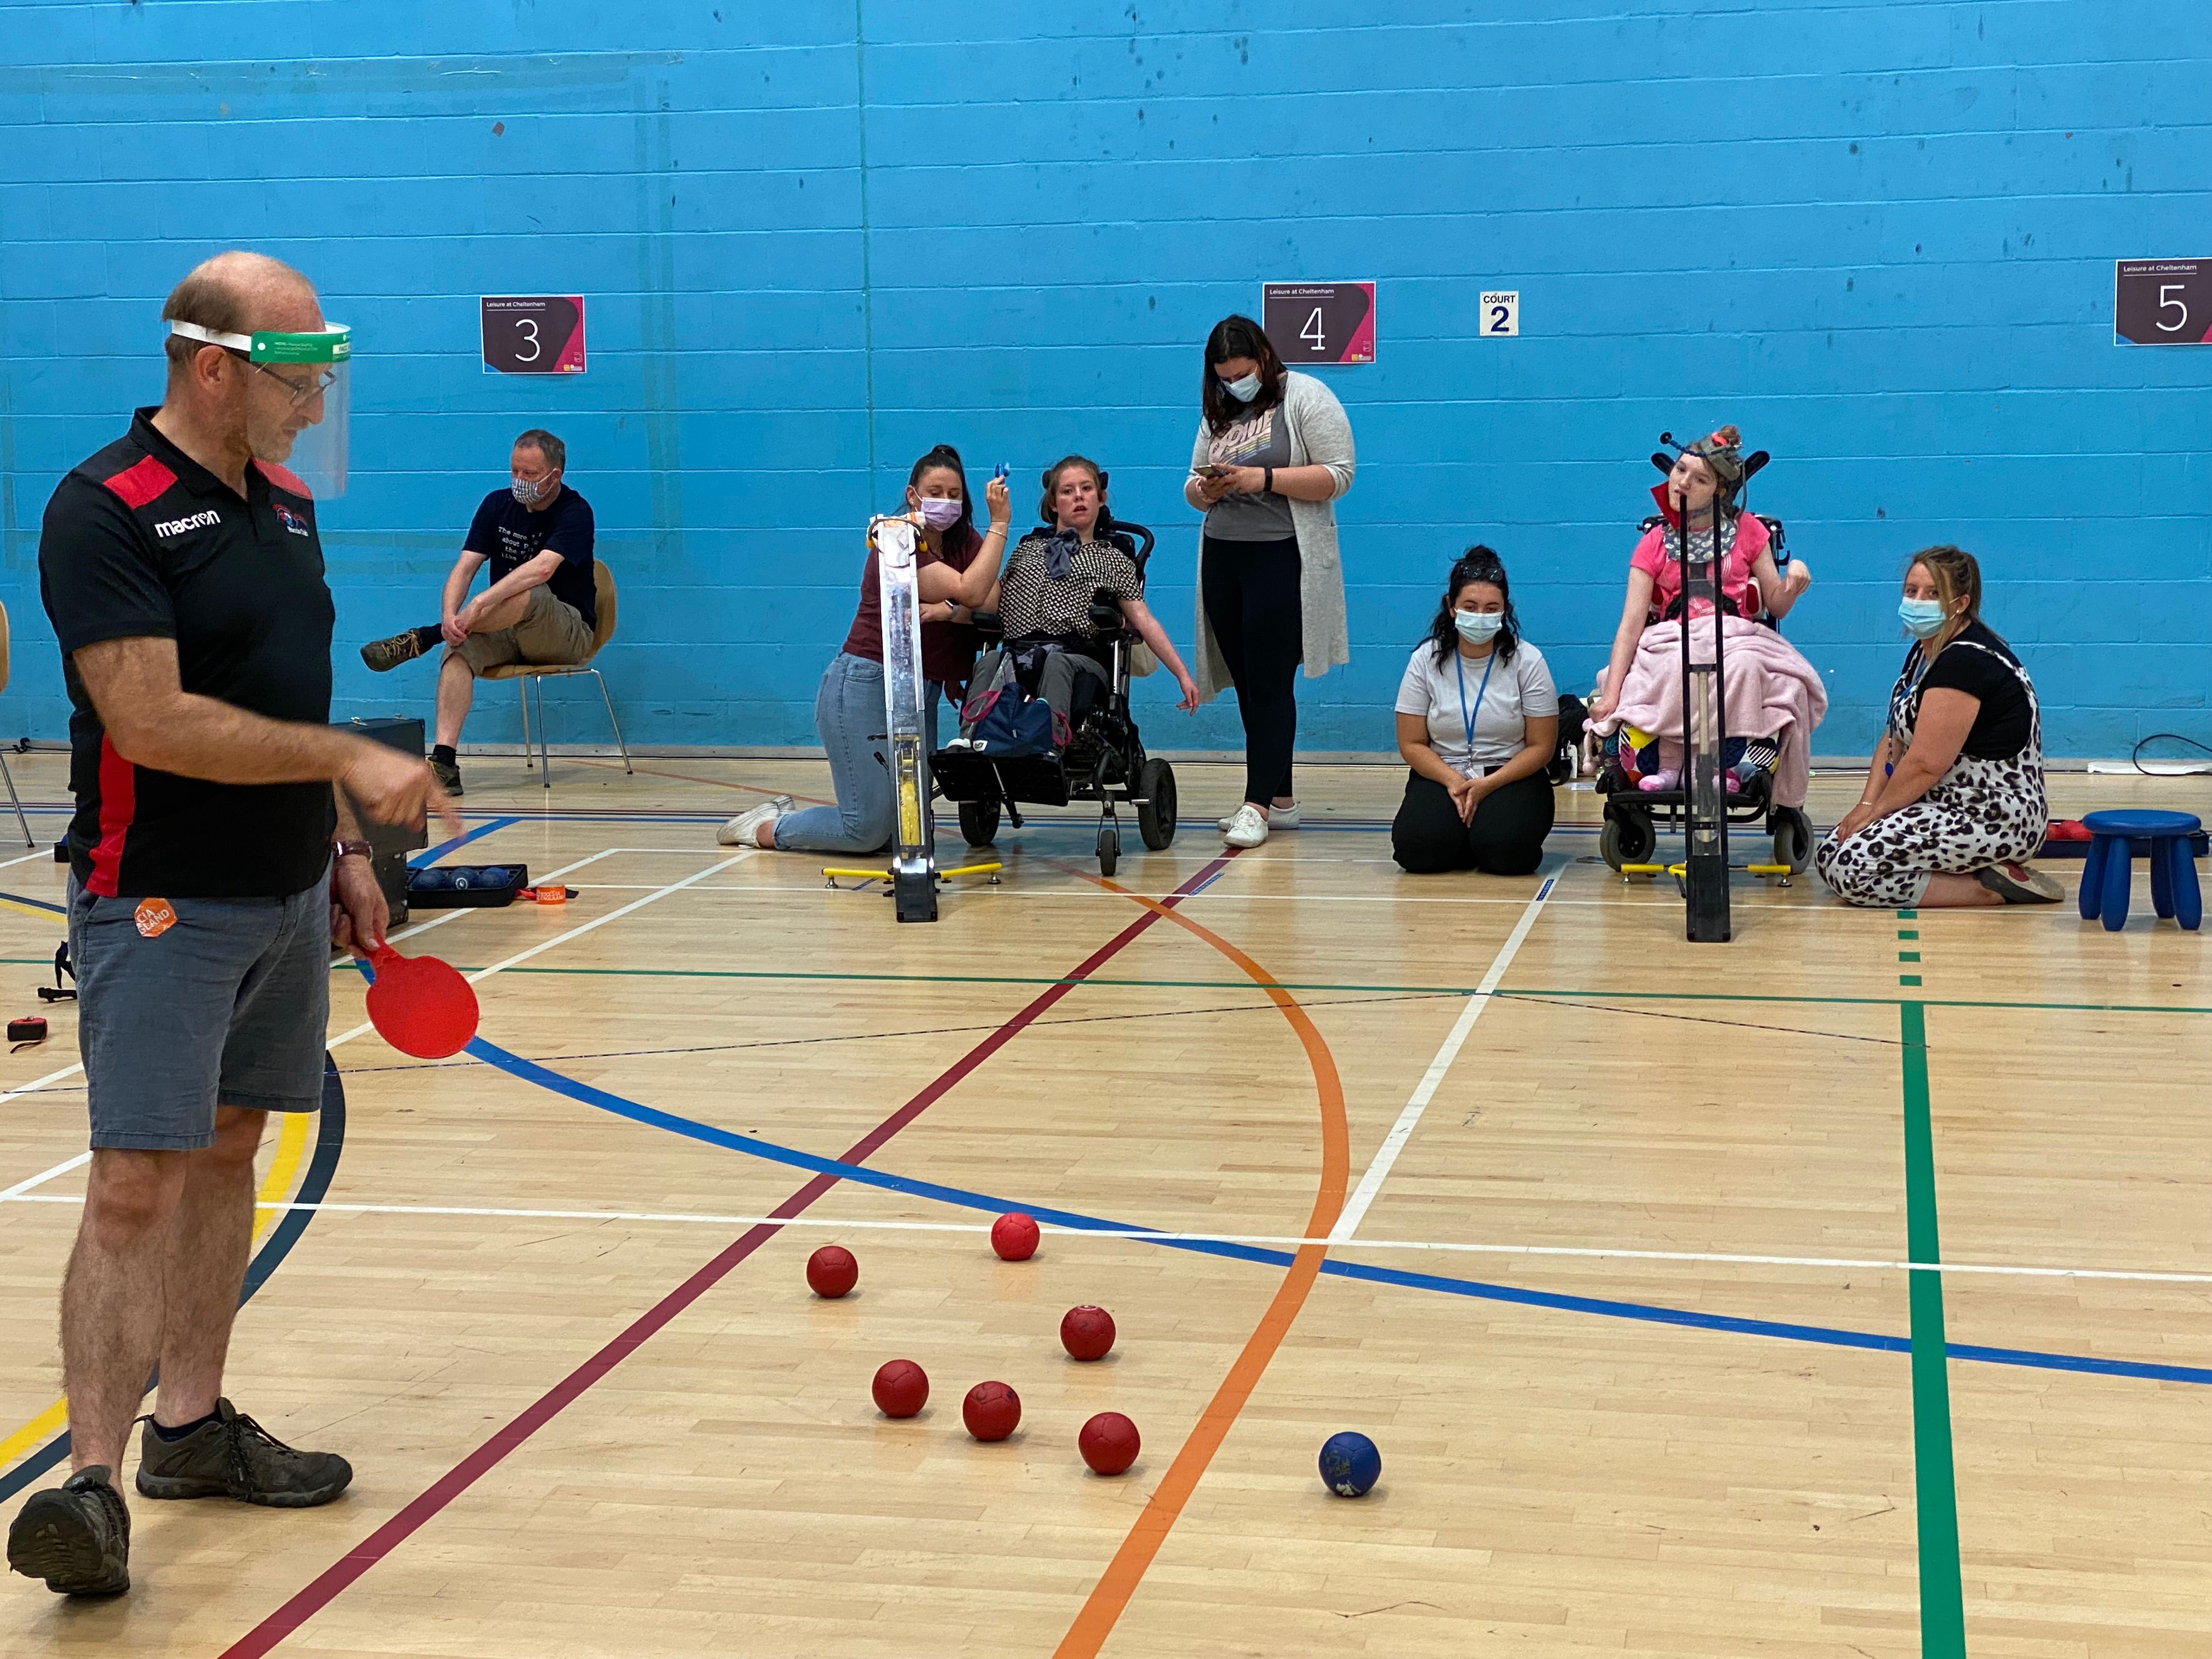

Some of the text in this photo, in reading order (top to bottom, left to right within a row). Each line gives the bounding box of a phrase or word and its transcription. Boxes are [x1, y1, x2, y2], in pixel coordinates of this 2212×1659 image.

[1483, 295, 1516, 303] COURT
[2156, 285, 2187, 331] 5
[1300, 307, 1325, 350] 4
[1491, 306, 1510, 332] 2
[515, 319, 540, 362] 3
[154, 510, 221, 538] macron
[498, 526, 511, 535] The
[501, 537, 520, 547] about
